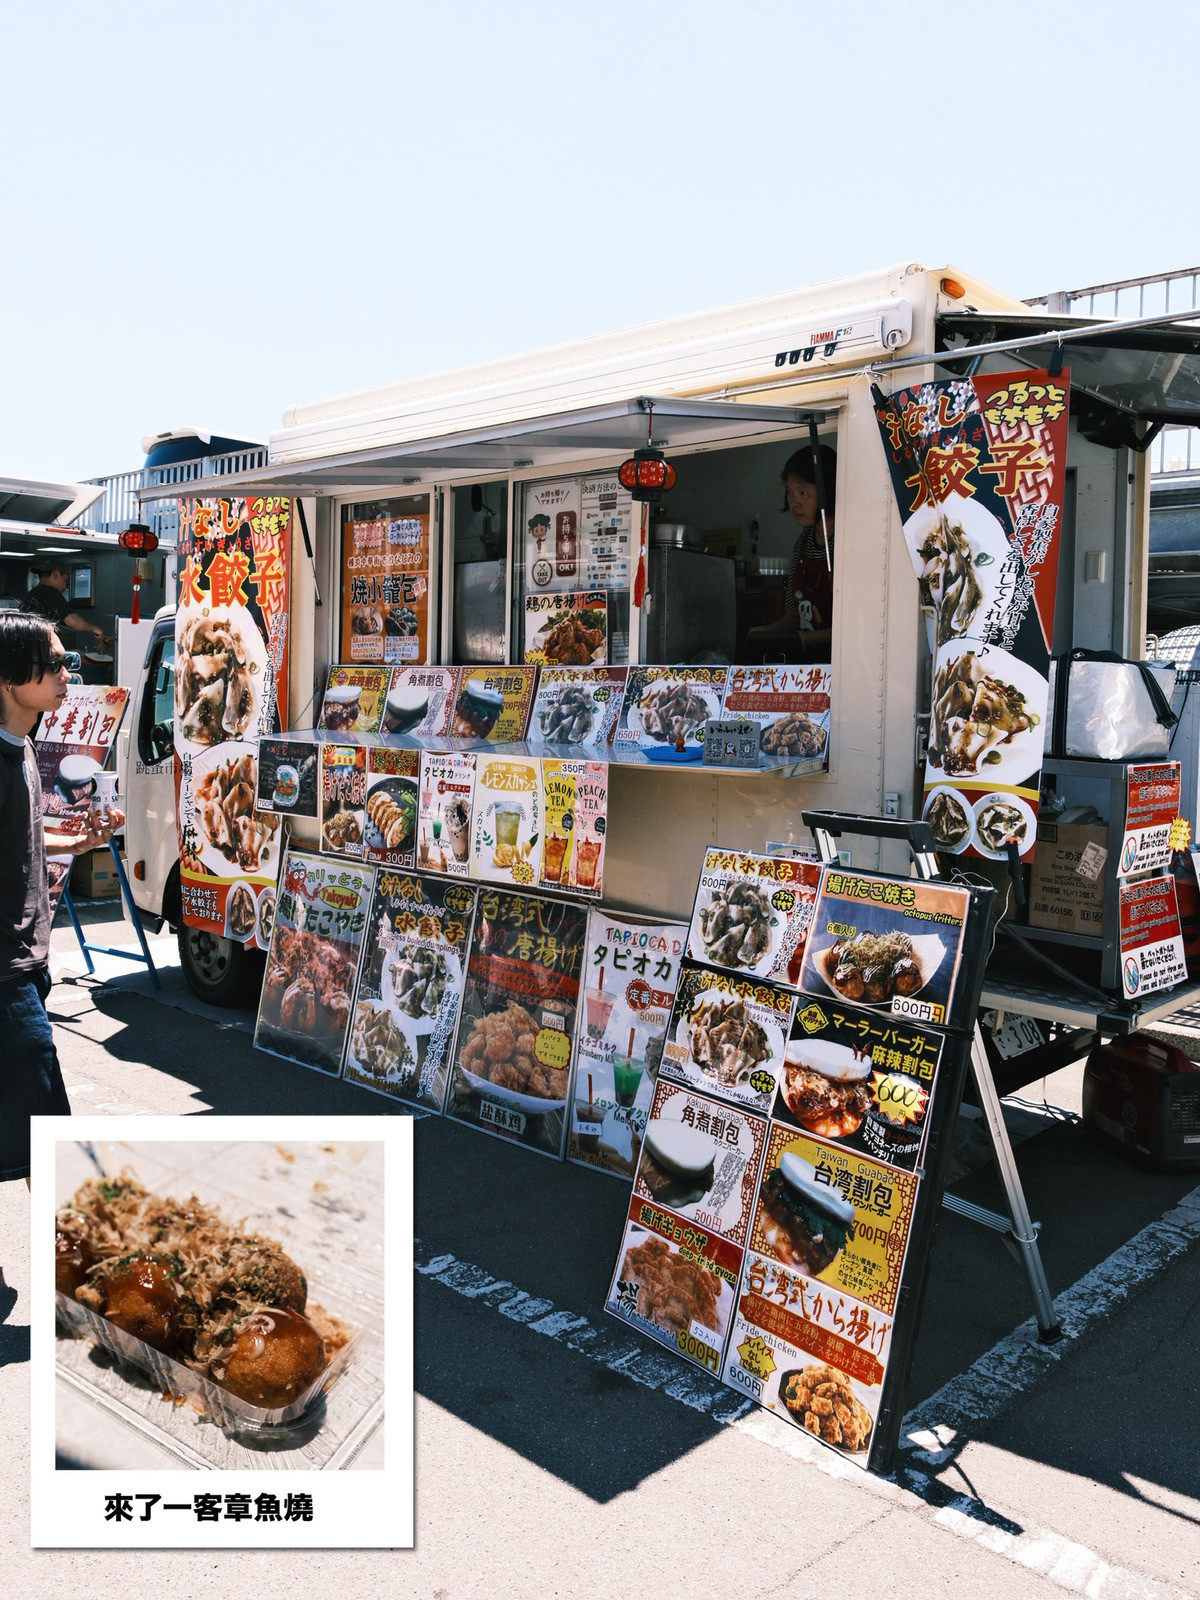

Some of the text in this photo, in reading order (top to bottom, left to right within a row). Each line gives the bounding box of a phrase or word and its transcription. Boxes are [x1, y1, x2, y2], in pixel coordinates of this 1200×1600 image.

[810, 331, 834, 345] FIAMMA
[984, 380, 1067, 406] つるっと
[984, 403, 1067, 429] もちもち
[178, 549, 285, 608] 水餃子
[998, 503, 1060, 651] 自家製焦がしねぎが甘さと
[526, 594, 586, 612] 鶏の唐揚げ
[408, 674, 444, 687] 角煮割包
[483, 676, 524, 691] 台湾割包
[541, 668, 609, 683] 汁なし水餃子
[646, 668, 727, 683] 汁なし水餃子
[538, 690, 559, 699] 600円
[723, 711, 740, 719] Fride
[618, 728, 640, 741] 650円
[424, 766, 454, 779] タピオカ
[562, 763, 585, 775] 350円
[544, 782, 573, 798] LEMON
[550, 795, 566, 807] TEA
[577, 784, 606, 801] PEACH
[583, 798, 599, 810] TEA
[345, 842, 362, 854] 600円
[385, 851, 413, 868] 300円
[448, 863, 467, 874] 500円
[514, 866, 530, 877] 350
[705, 852, 794, 882] 汁なし水餃子
[380, 875, 423, 903] 汁なし
[701, 876, 727, 891] 600円
[826, 875, 916, 907] 揚げたこ焼き
[480, 890, 550, 934] 台湾式
[903, 908, 964, 928] octopus fritters
[1050, 905, 1074, 917] 60150
[394, 911, 466, 946] 水餃子
[605, 927, 669, 953] TAPIOCA
[826, 921, 857, 938] 6個入り
[407, 936, 461, 955] boiled dumplings
[507, 931, 586, 973] 唐揚げ
[593, 944, 673, 982] タピオカ
[628, 988, 652, 1005] 定番
[701, 973, 792, 1012] 汁なし水餃子
[639, 1011, 665, 1026] 500円
[892, 1001, 932, 1018] 600円
[543, 1016, 564, 1030] 600円
[831, 1012, 938, 1054] マーラーバーガー
[580, 1035, 617, 1054] イチゴミルク
[871, 1045, 935, 1081] 麻辣割包
[876, 1077, 919, 1108] 600
[686, 1095, 744, 1126] Kakuni Guabao
[680, 1104, 741, 1147] 角煮割包
[712, 1138, 746, 1156] カクニバーガー
[864, 1126, 921, 1154] とマヨネーズの相性
[815, 1146, 896, 1186] Taiwan Guabao
[813, 1160, 894, 1211] 台湾割包
[840, 1193, 892, 1219] タイワンバーガー
[640, 1203, 708, 1251] 揚げギョウザ
[694, 1208, 723, 1232] 500円
[852, 1219, 888, 1249] 700円
[678, 1244, 738, 1284] deep-fried gyoza
[749, 1257, 893, 1356] 台湾式から揚げ
[736, 1317, 798, 1359] Fride chicken
[744, 1304, 877, 1383] などを混ぜたスパイスをかけた一品
[745, 1294, 880, 1371] 揚げた鶏肉に五香粉、胡椒、唐辛子
[678, 1330, 720, 1371] 300円
[743, 1337, 773, 1359] スパイス
[729, 1364, 763, 1397] 600円
